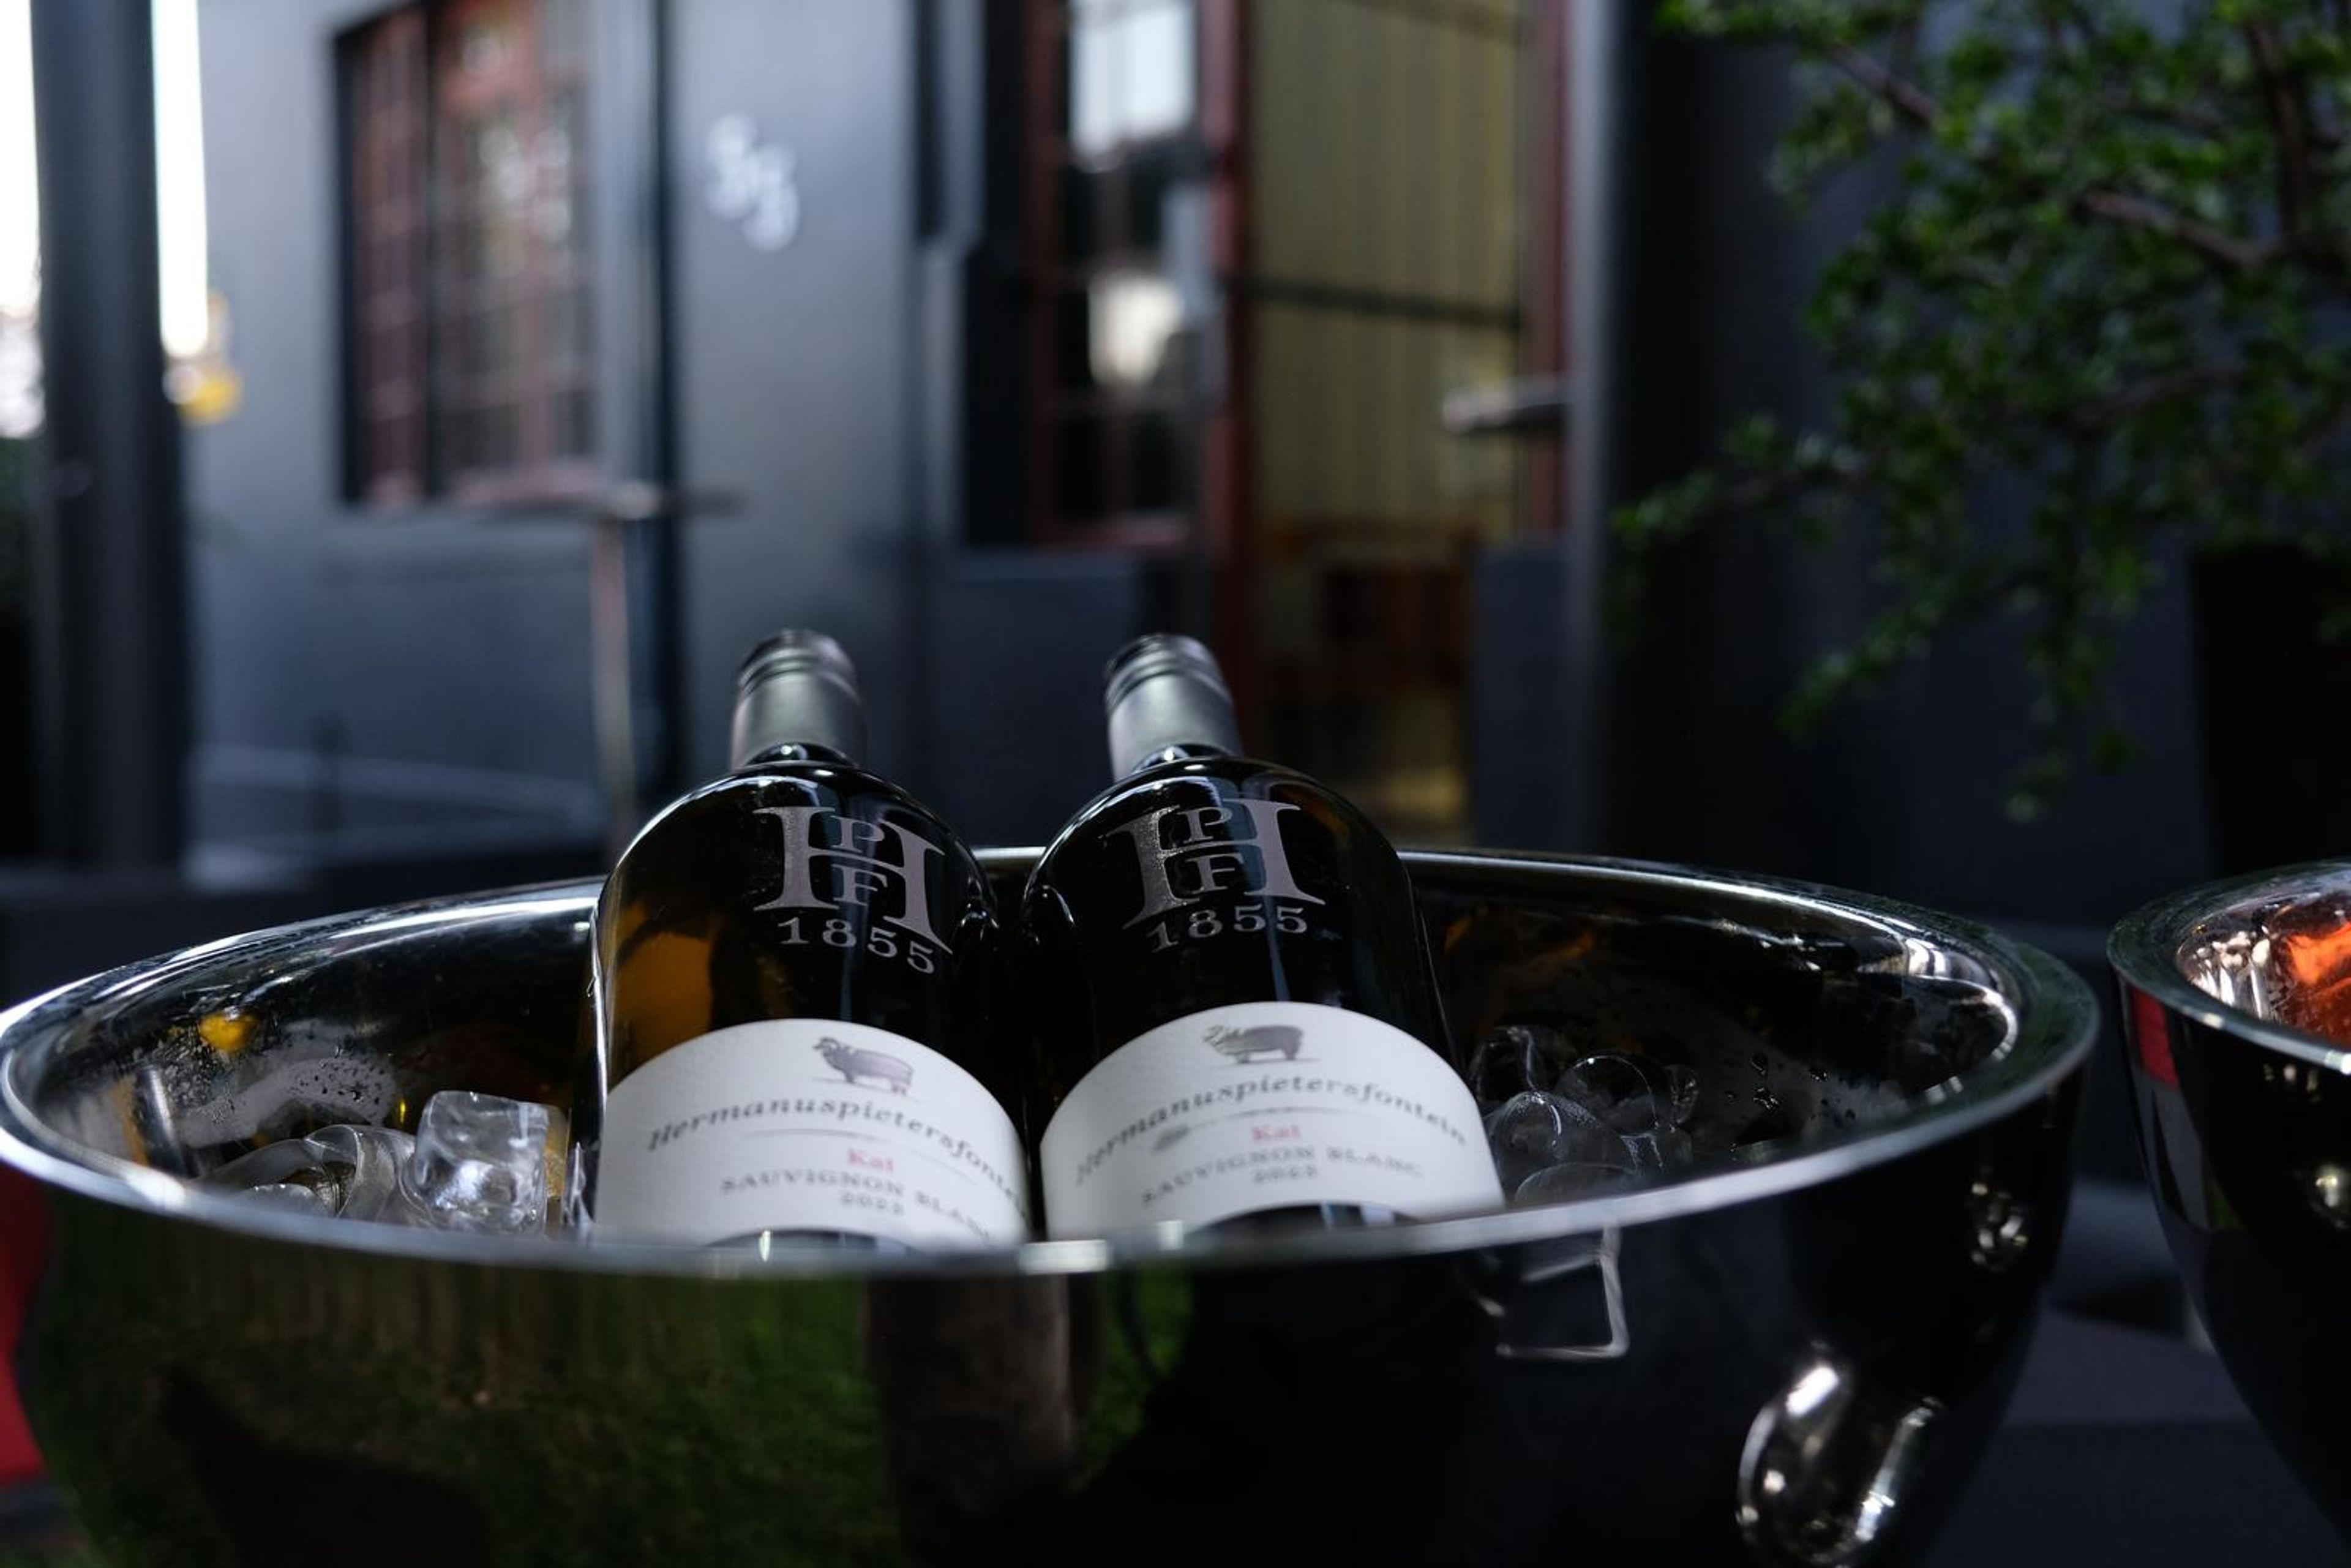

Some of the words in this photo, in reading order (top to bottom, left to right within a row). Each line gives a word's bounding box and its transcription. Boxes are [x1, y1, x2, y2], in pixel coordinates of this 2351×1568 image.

[778, 917, 935, 975] 1855
[1147, 904, 1308, 953] 1855
[1076, 1073, 1468, 1187] Hermanuspietersfontein
[720, 1168, 905, 1197] SAUVIGNON
[1139, 1144, 1316, 1209] SAUVIGNON
[1326, 1146, 1424, 1179] BLANC
